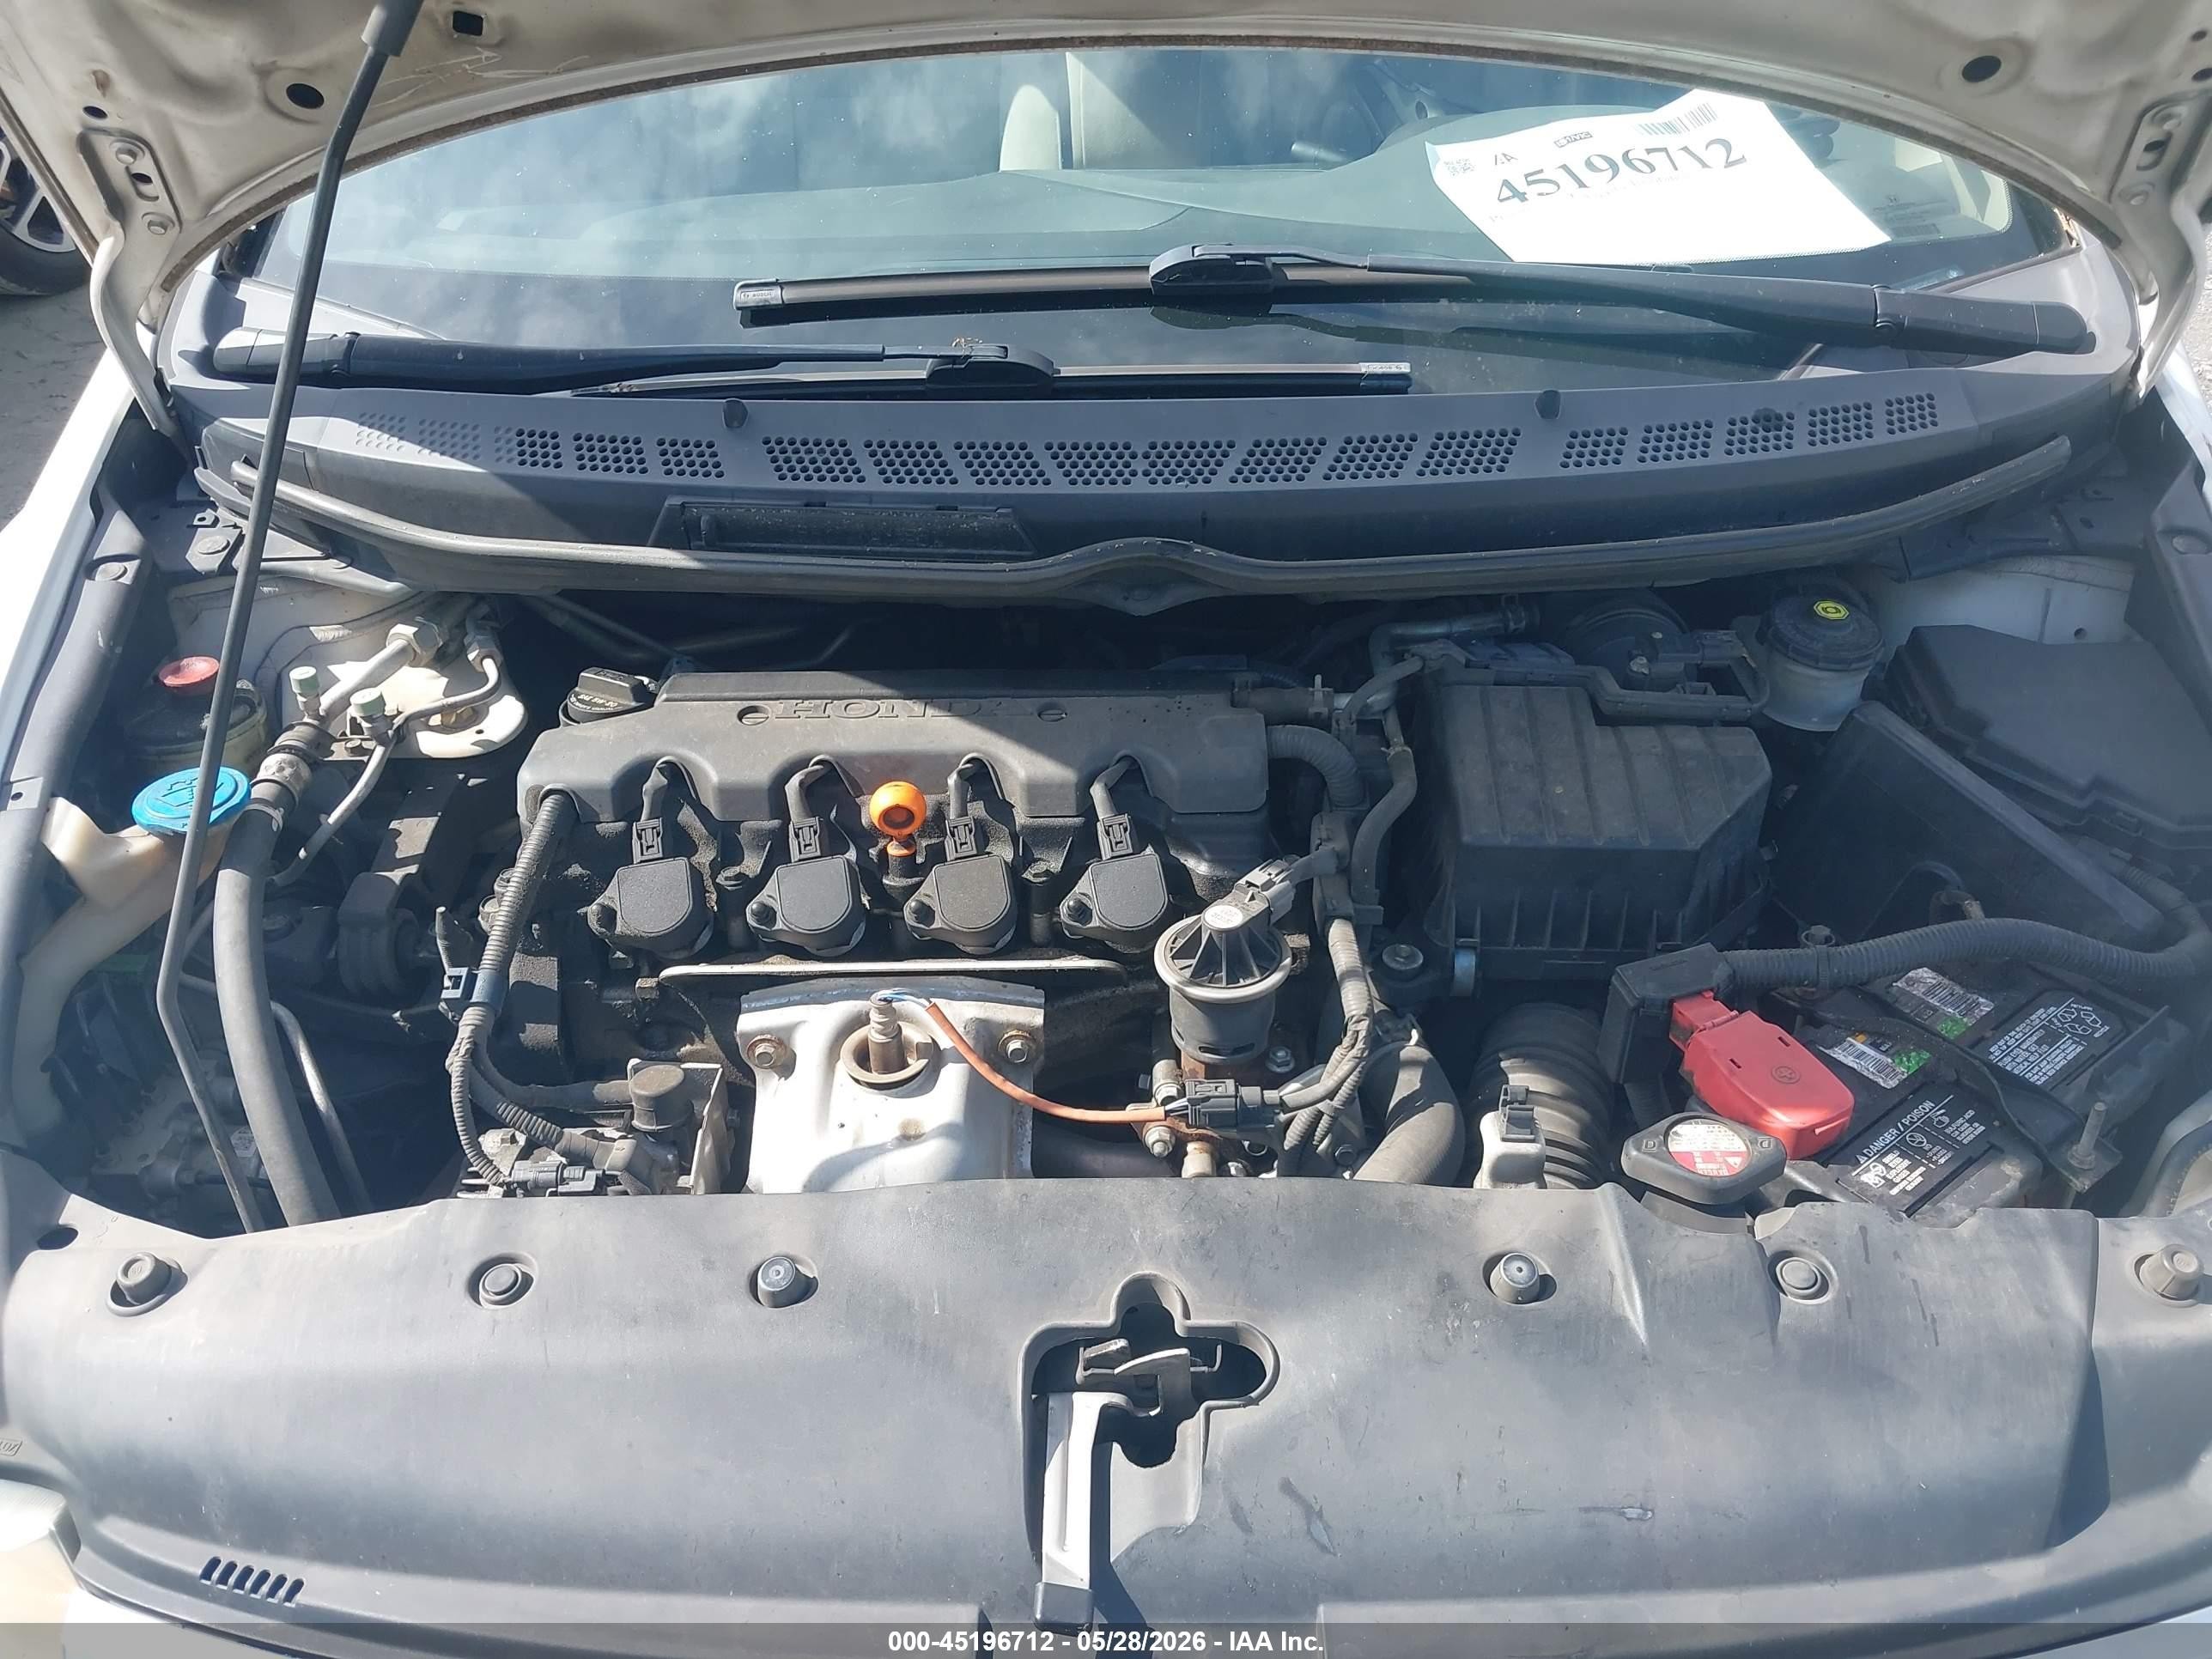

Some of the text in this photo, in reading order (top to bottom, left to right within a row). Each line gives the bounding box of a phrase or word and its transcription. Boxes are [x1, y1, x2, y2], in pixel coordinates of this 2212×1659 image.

[1498, 138, 1747, 203] 45196712
[775, 699, 1035, 720] HONDA
[1863, 1128, 1901, 1158] DANGER
[1901, 1100, 1936, 1126] POISON
